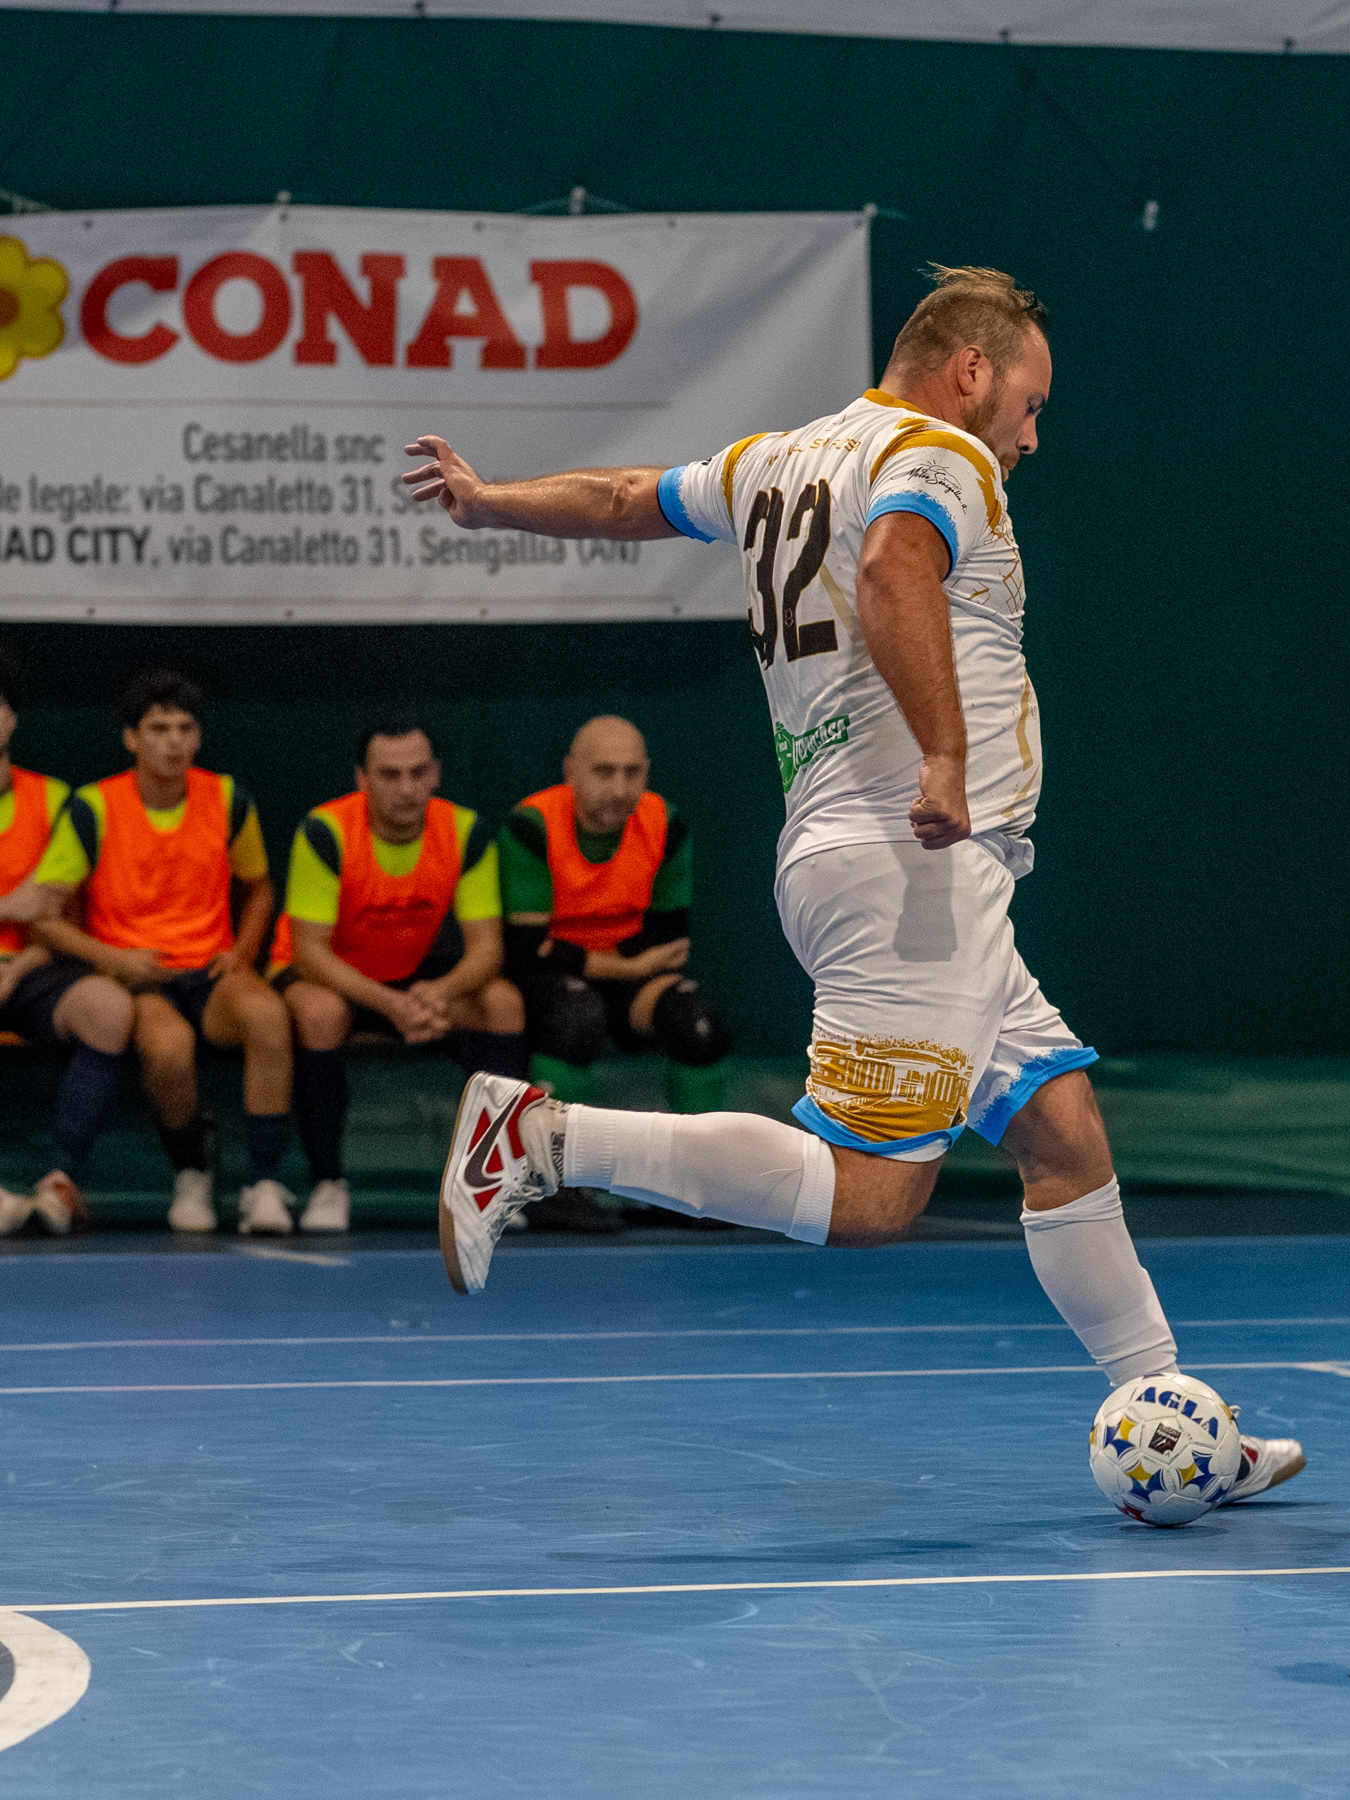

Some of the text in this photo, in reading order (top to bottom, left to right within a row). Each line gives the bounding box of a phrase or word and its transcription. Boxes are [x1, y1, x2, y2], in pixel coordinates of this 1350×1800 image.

[80, 251, 639, 370] CONAD
[183, 422, 384, 463] Cesanella snc
[29, 473, 131, 524] legale:
[139, 473, 185, 513] via
[194, 473, 333, 514] Canaletto
[65, 524, 160, 569] CITY,
[168, 525, 213, 565] via
[219, 524, 361, 566] Canaletto
[743, 478, 838, 670] 32
[1135, 1386, 1219, 1441] AGLA
